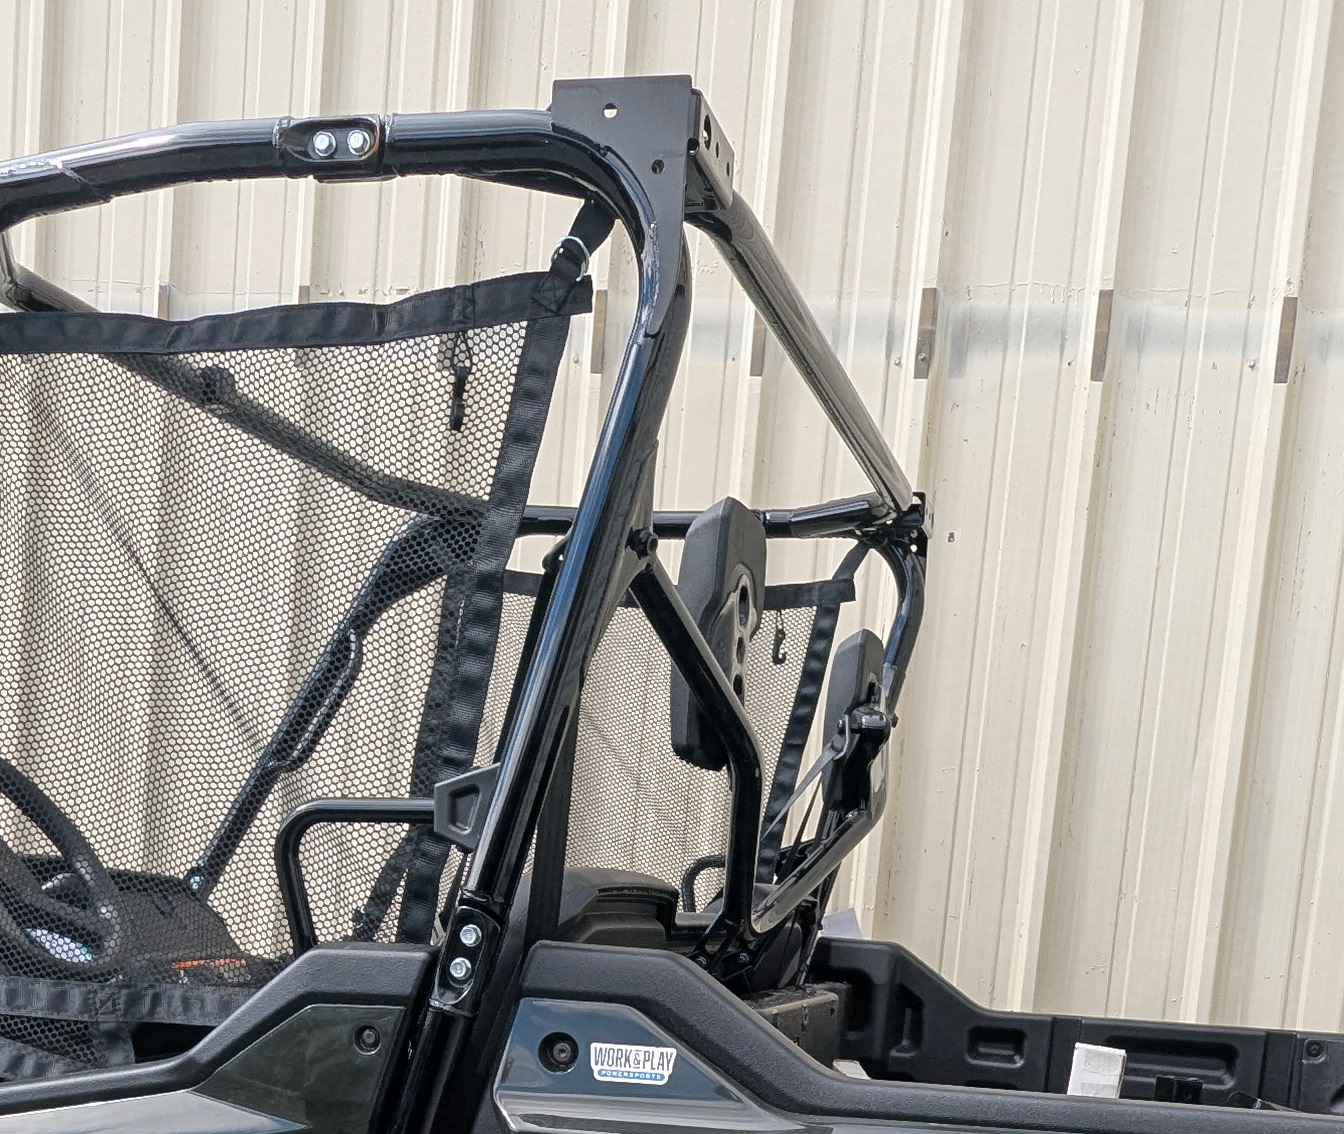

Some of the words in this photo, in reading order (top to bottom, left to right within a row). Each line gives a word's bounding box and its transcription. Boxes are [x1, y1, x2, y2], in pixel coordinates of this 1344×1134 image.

[594, 1047, 633, 1069] WORK
[642, 1050, 674, 1072] PLAY
[600, 1071, 662, 1080] POWERSPORTS
